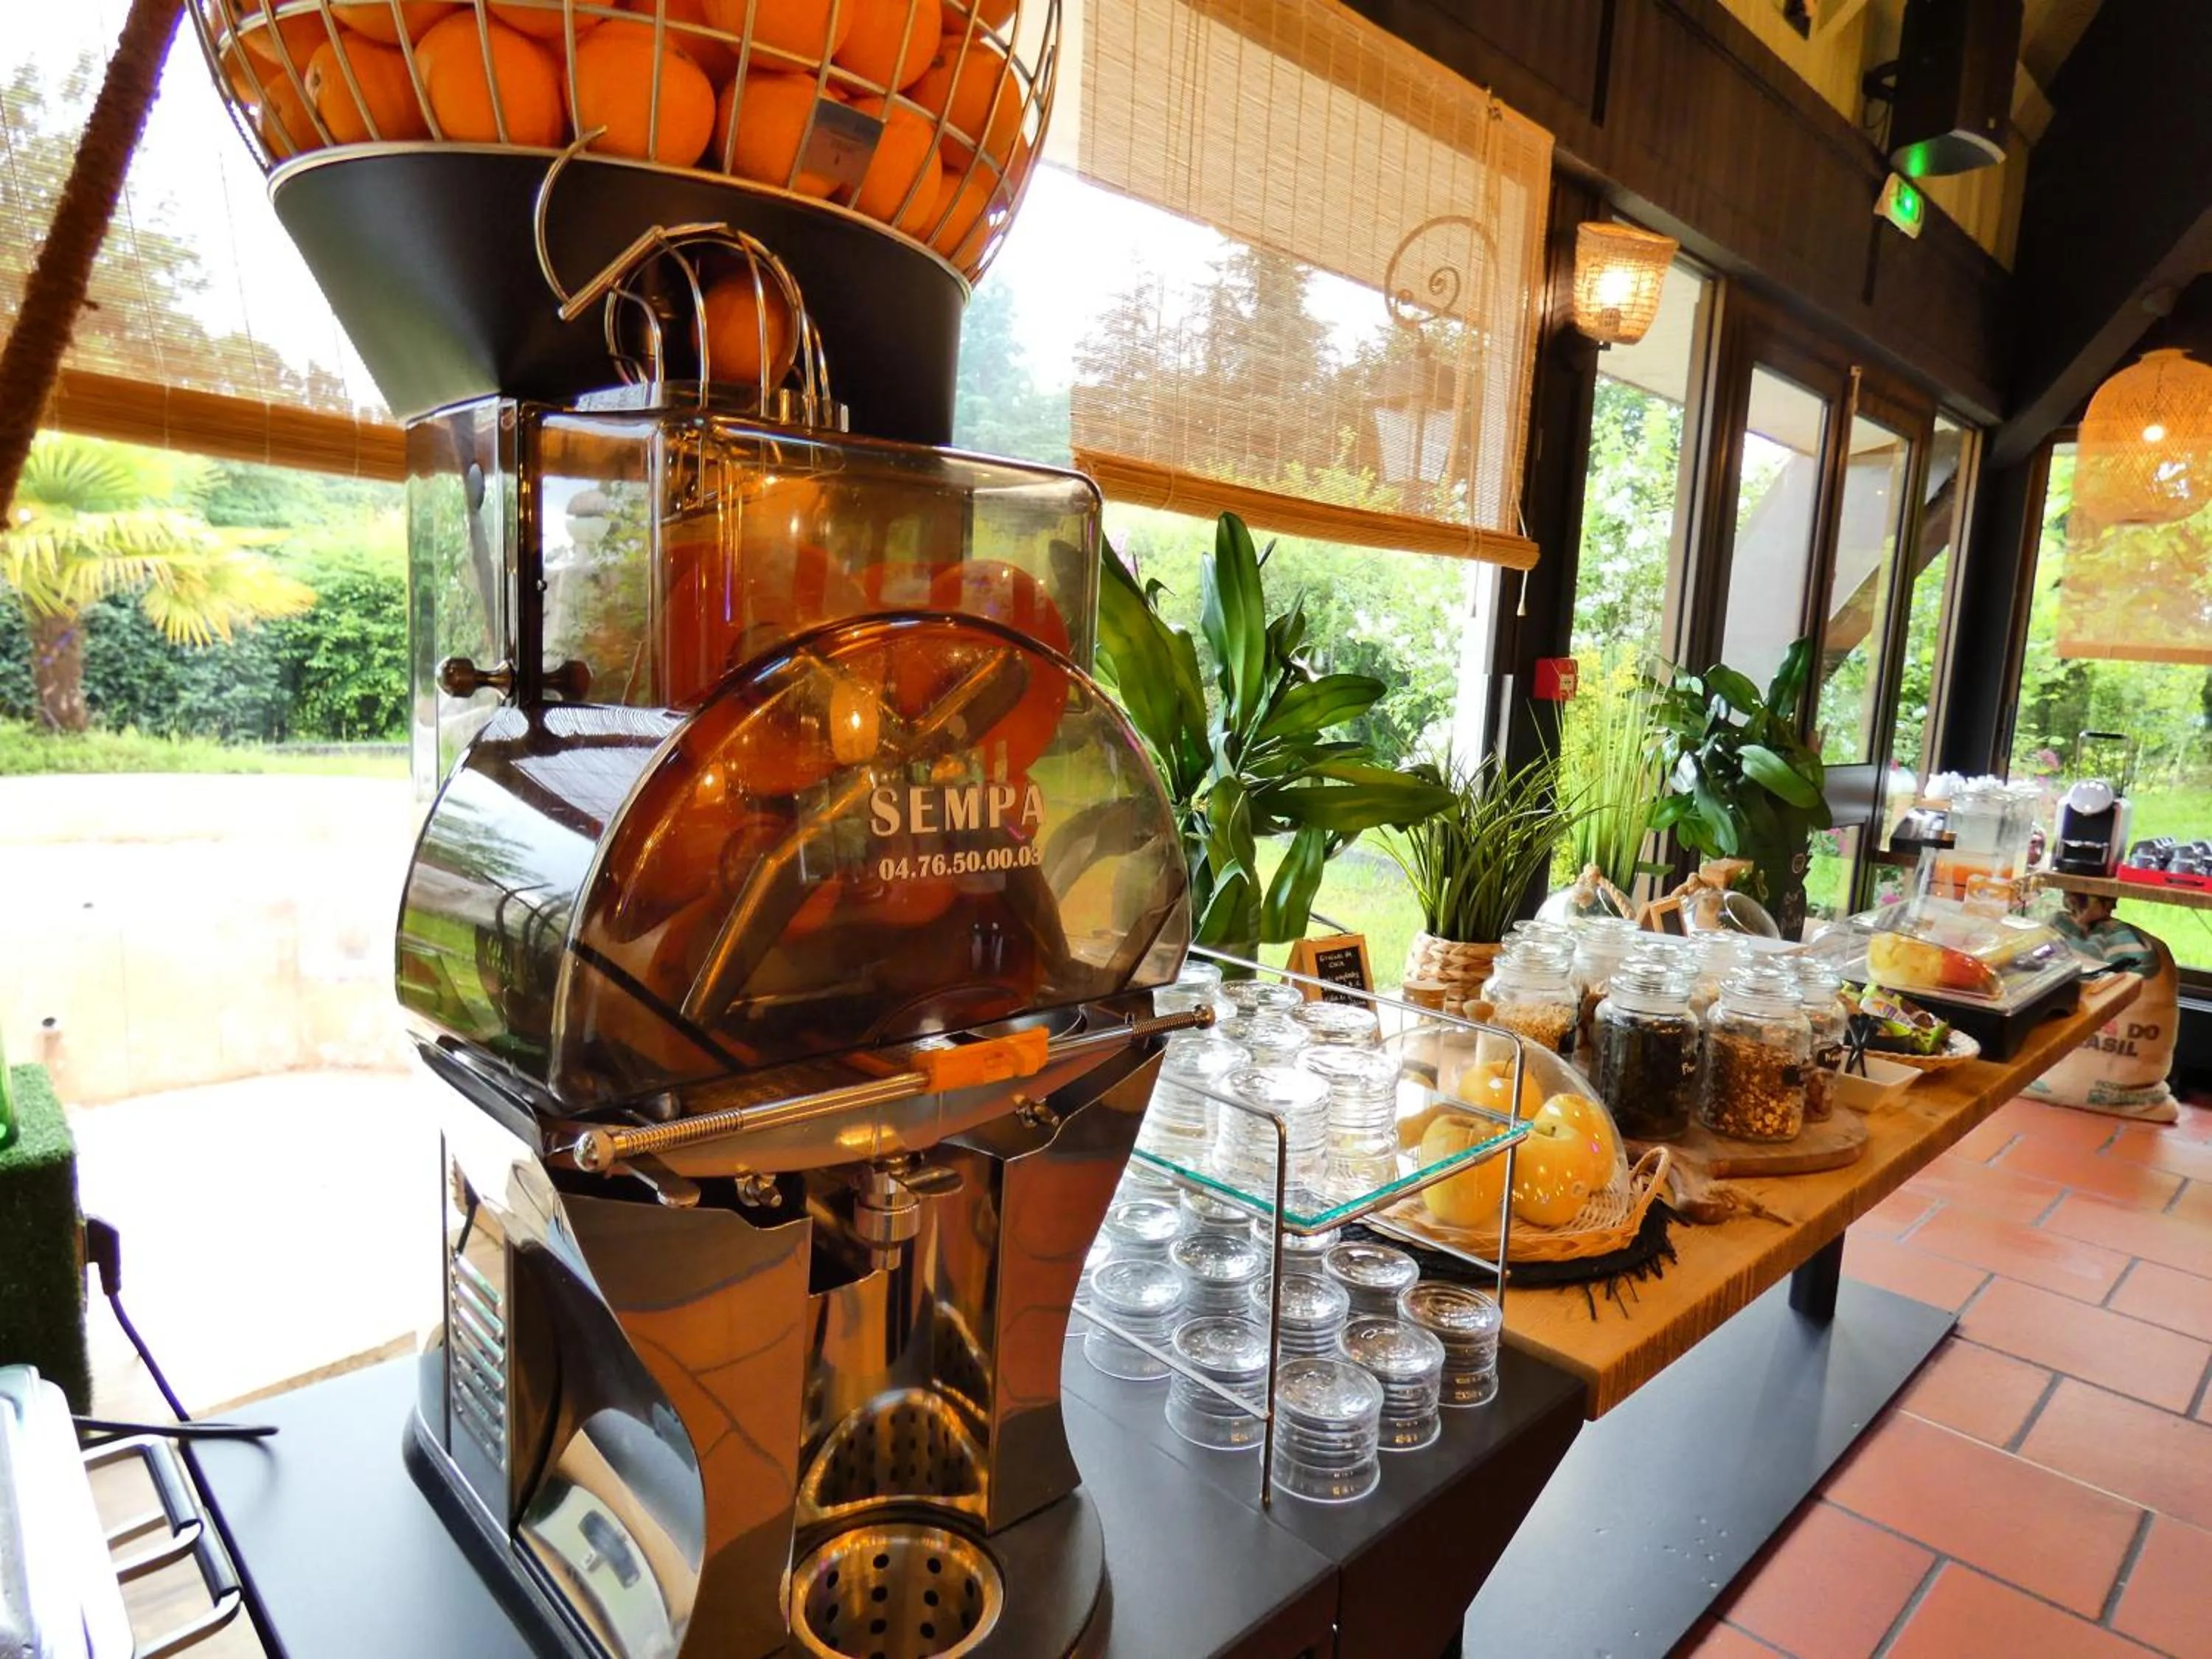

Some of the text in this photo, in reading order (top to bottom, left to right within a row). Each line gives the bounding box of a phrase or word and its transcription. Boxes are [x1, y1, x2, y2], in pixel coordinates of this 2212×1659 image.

[870, 784, 1044, 836] SEMPA
[878, 846, 1041, 881] 04.76.50.00.03
[2081, 1034, 2138, 1056] ASIL
[2127, 1023, 2160, 1040] DO
